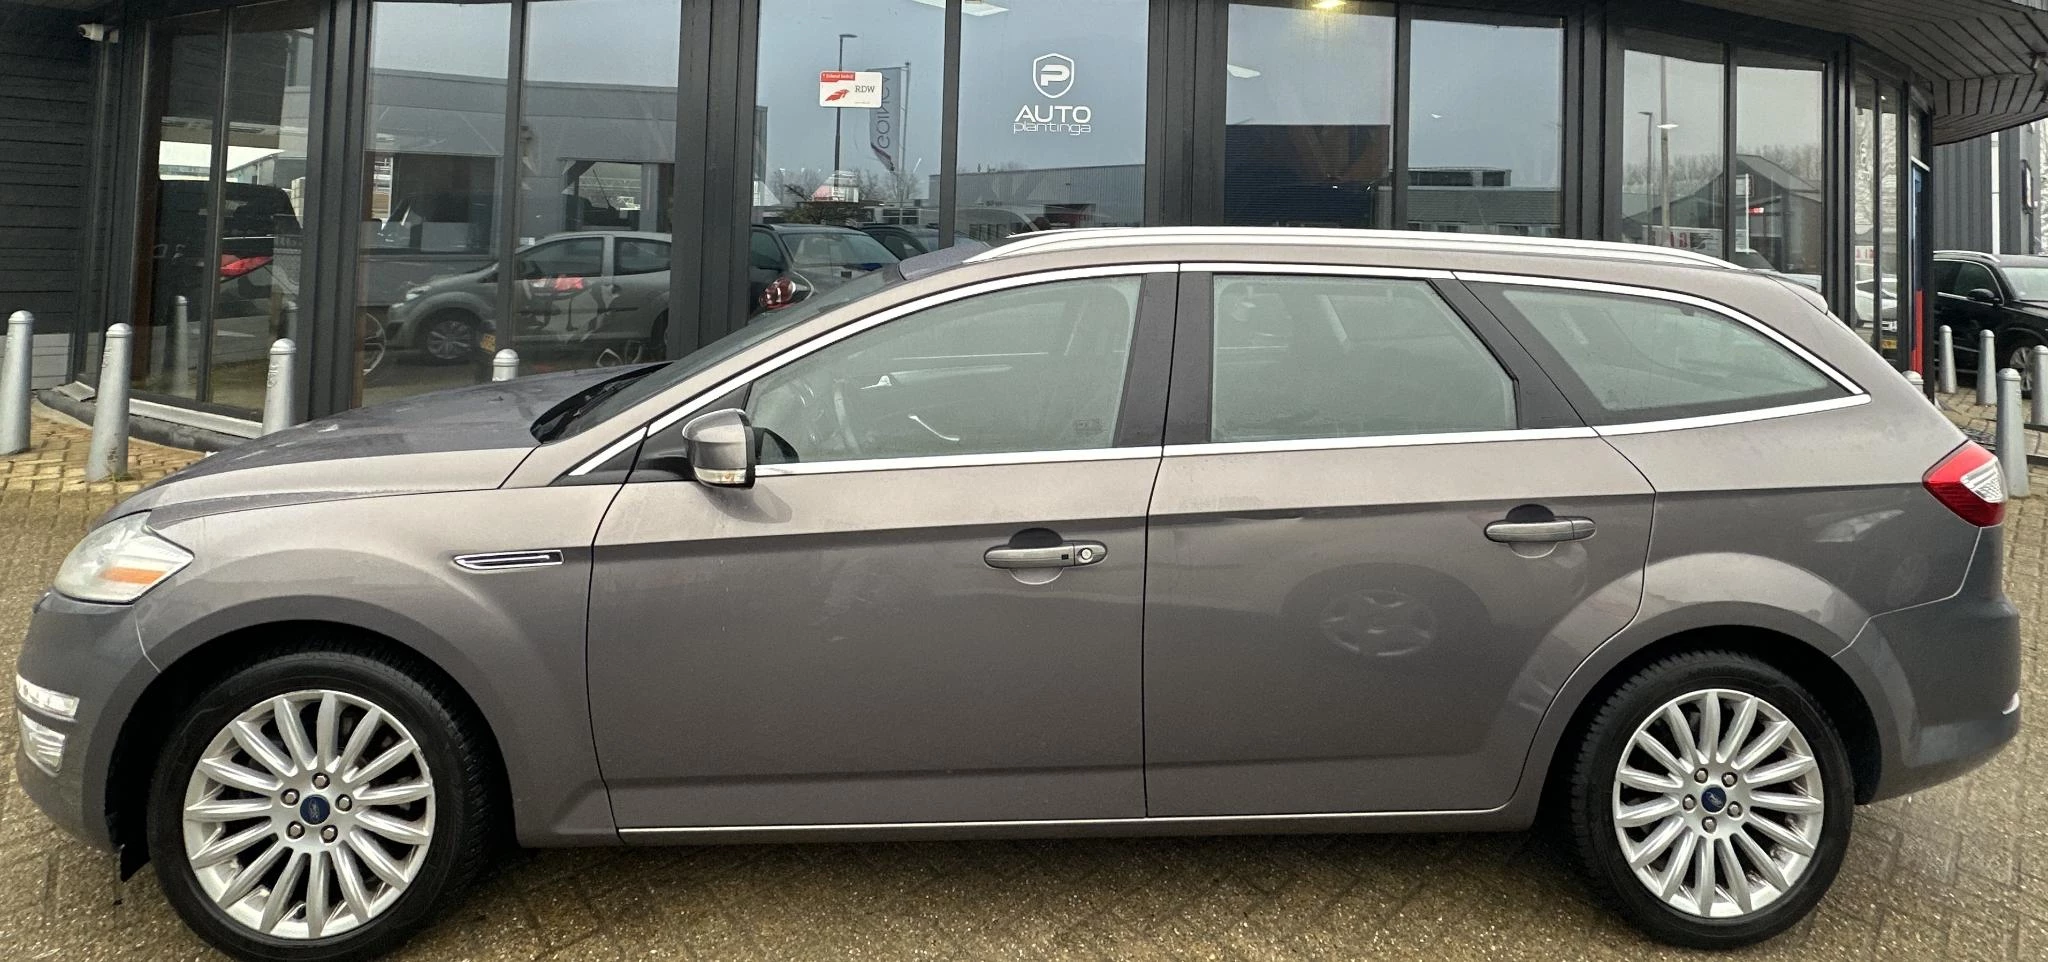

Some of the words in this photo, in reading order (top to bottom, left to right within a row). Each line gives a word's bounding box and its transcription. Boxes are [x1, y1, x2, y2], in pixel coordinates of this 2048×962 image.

[1041, 64, 1070, 86] P
[854, 85, 876, 93] RDW
[1015, 105, 1091, 123] AUTO
[1013, 121, 1091, 136] plantinga
